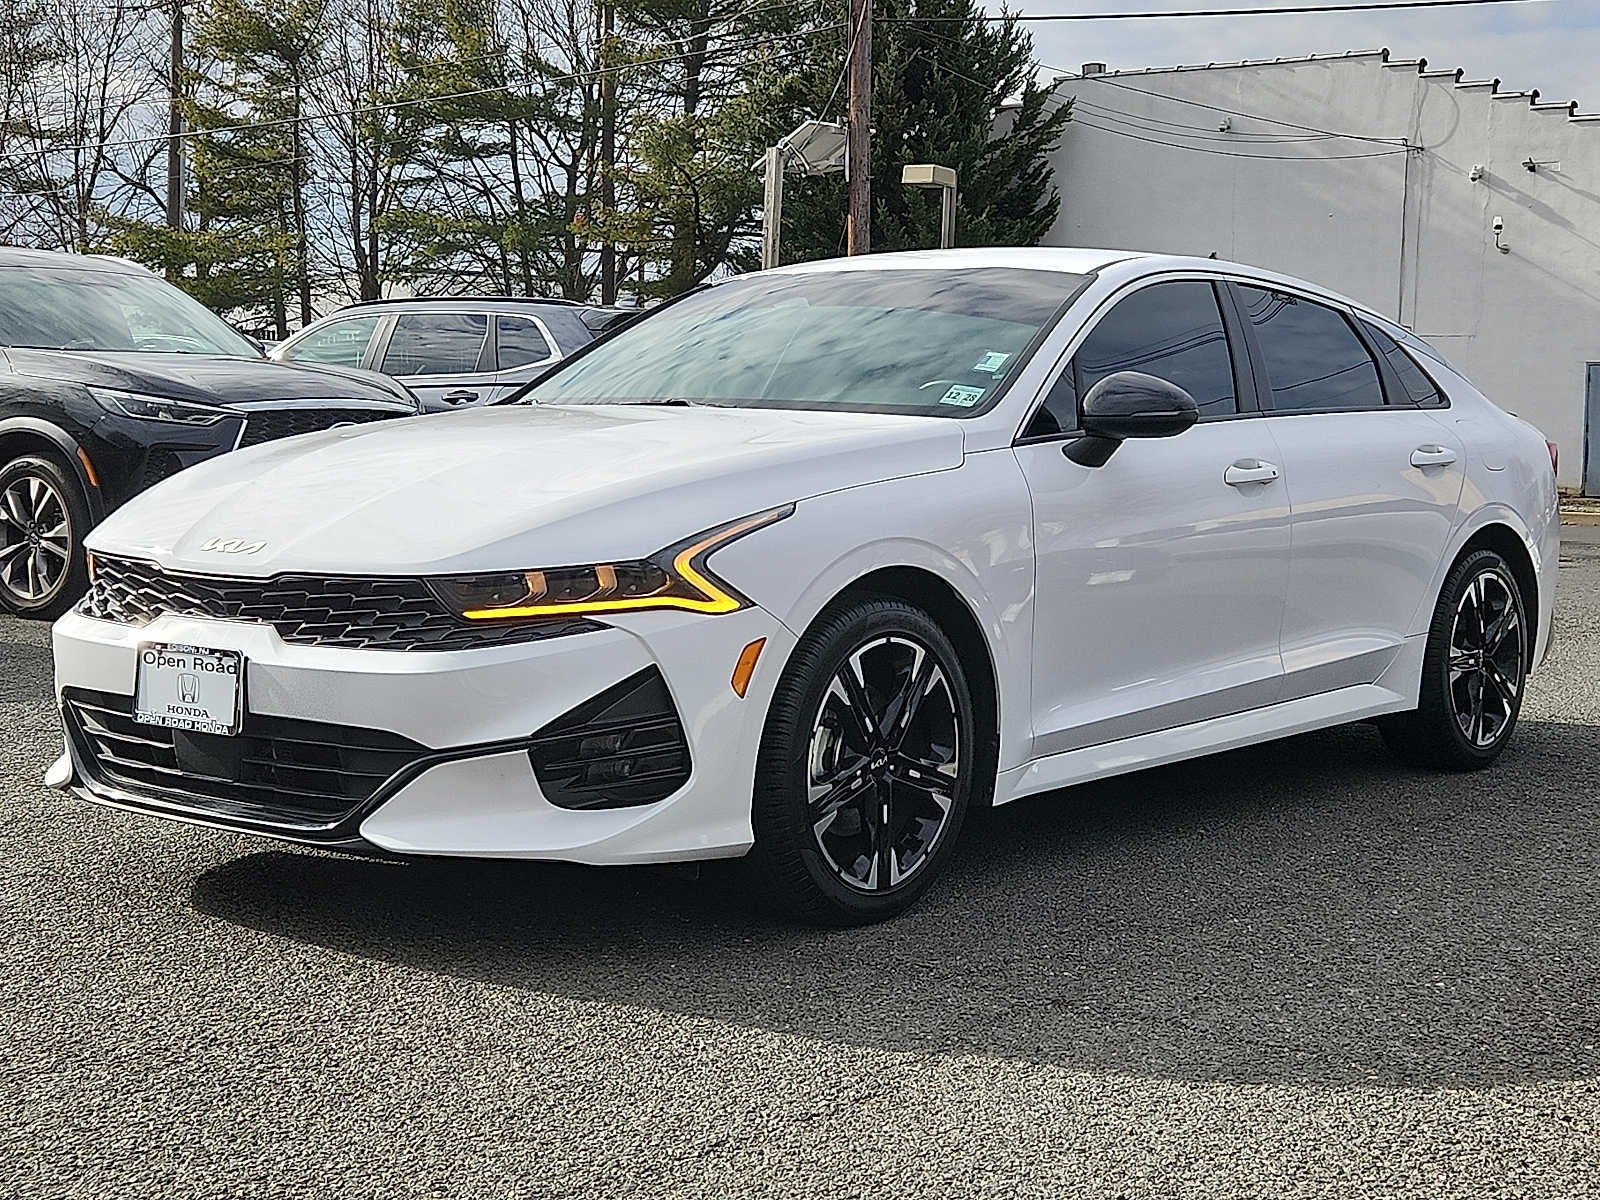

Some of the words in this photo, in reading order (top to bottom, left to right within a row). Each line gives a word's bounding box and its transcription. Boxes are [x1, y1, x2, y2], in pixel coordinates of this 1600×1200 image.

[946, 391, 960, 400] 12
[199, 536, 268, 555] KIA
[143, 651, 186, 669] Open
[193, 657, 239, 675] Road
[167, 705, 209, 718] HONDA
[165, 717, 193, 729] ROAD
[195, 722, 229, 735] HONDA
